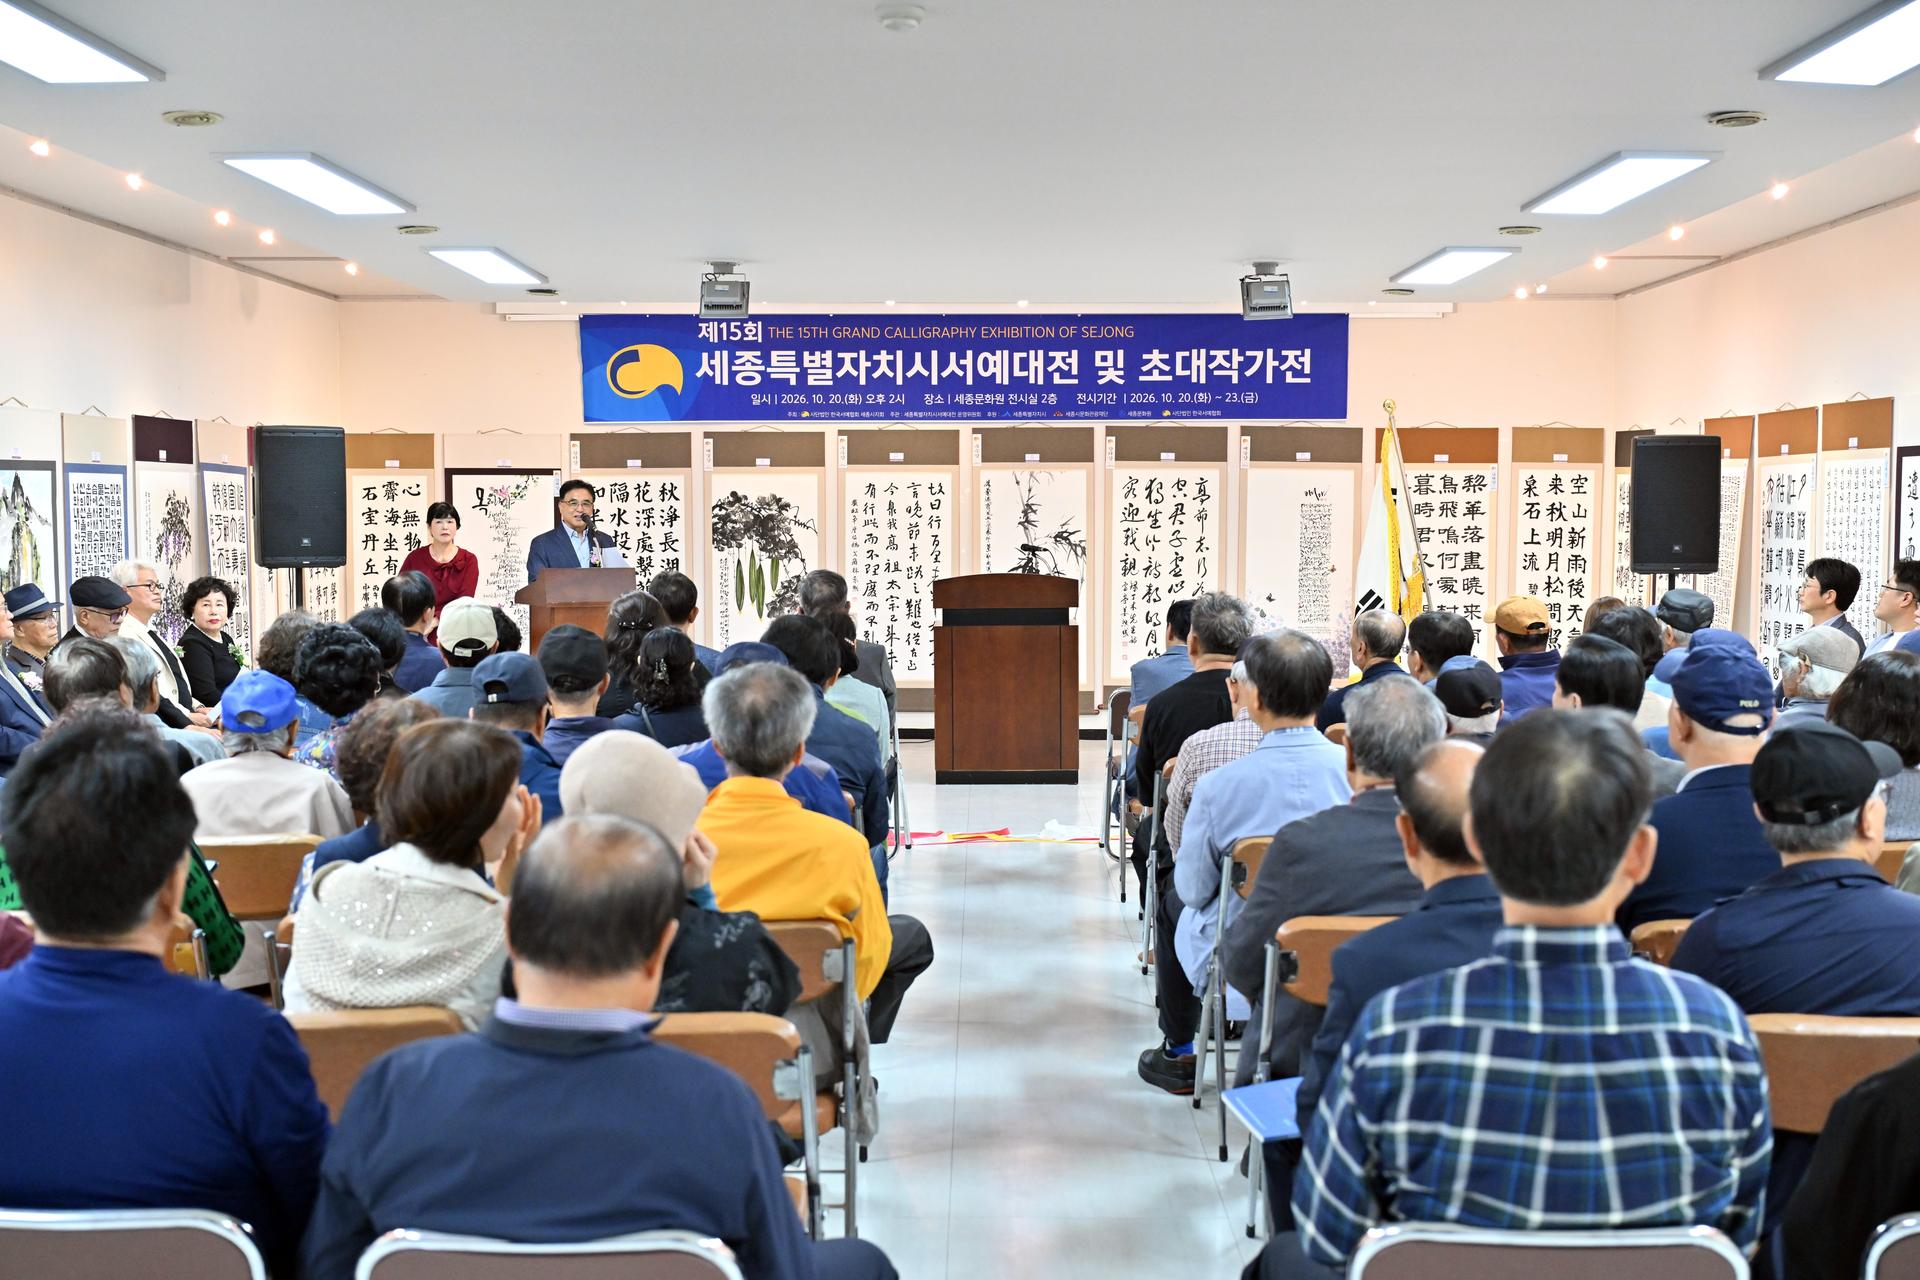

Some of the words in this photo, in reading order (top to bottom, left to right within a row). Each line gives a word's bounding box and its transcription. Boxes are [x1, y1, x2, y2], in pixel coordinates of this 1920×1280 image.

[697, 321, 763, 343] 제15회
[767, 326, 794, 339] THE
[797, 326, 829, 339] 15TH
[832, 326, 881, 339] GRAND
[884, 326, 978, 339] CALLIGRAPHY
[981, 326, 1055, 339] EXHIBITION
[1058, 326, 1078, 339] OF
[1081, 325, 1135, 339] SEJONG
[695, 349, 1079, 386] 세종특별자치시서예대전
[1094, 348, 1126, 385] 및
[1138, 347, 1312, 385] 초대작가전
[750, 393, 771, 406] 일시
[780, 393, 809, 405] 2026.
[811, 393, 826, 405] 10.
[828, 393, 863, 406] 20.(화)
[865, 393, 886, 405] 오후
[888, 393, 905, 405] 2시
[923, 393, 945, 406] 장소
[953, 393, 1005, 406] 세종문화원
[1007, 393, 1038, 405] 전시실
[1041, 392, 1058, 405] 2층
[1076, 392, 1118, 405] 전시기간
[1129, 392, 1159, 404] 2026.
[1161, 392, 1175, 404] 10.
[1178, 392, 1212, 404] 20.(화)
[1225, 392, 1259, 404] 23.(금)
[361, 486, 380, 576] 石室丹丘
[609, 482, 632, 559] 隔水投
[1522, 475, 1541, 572] 泉石上流
